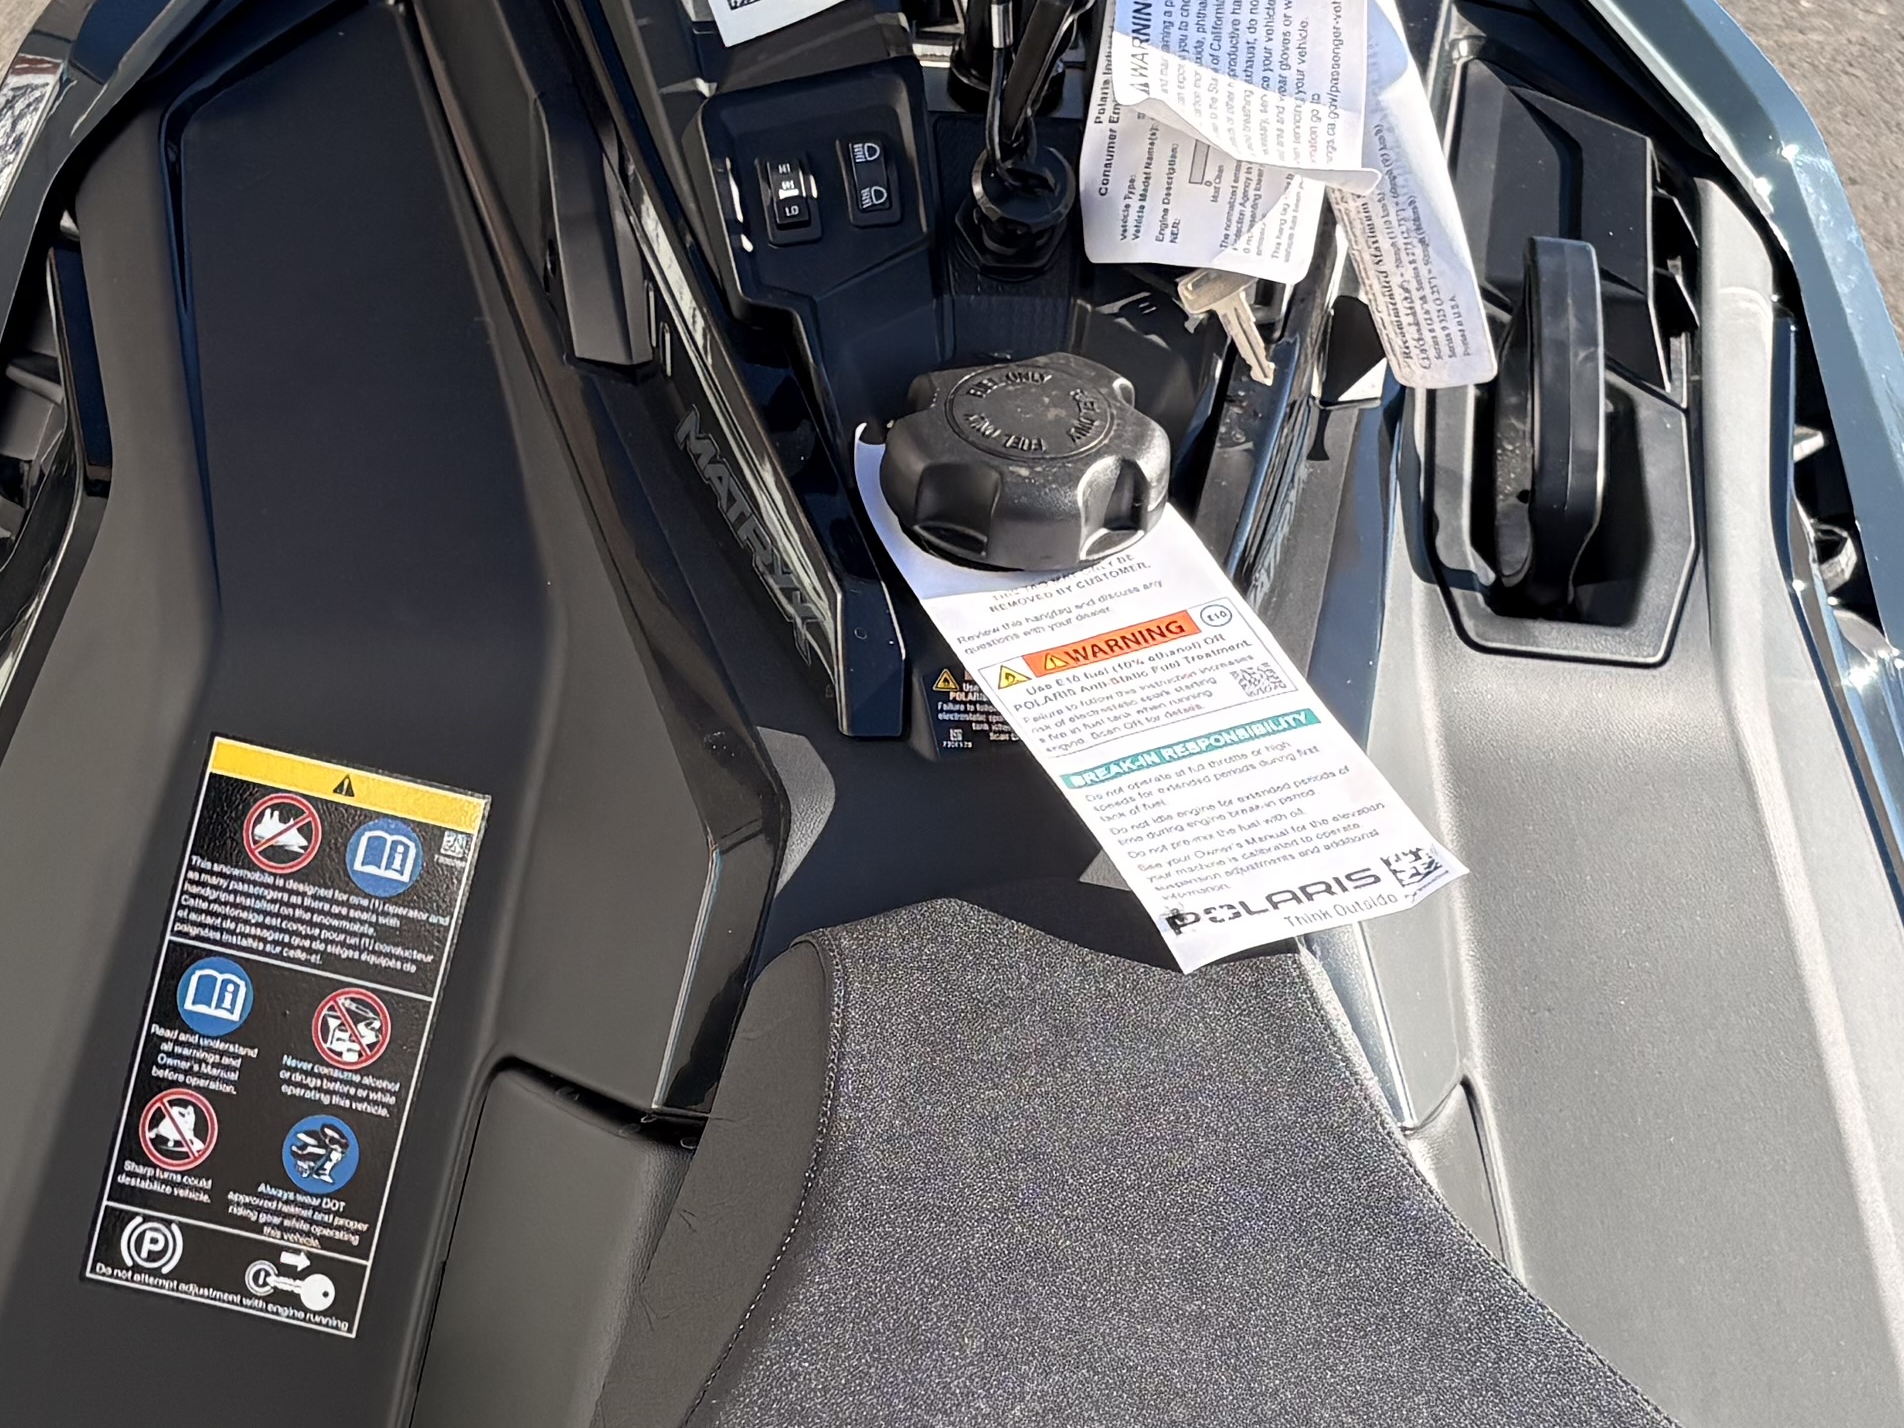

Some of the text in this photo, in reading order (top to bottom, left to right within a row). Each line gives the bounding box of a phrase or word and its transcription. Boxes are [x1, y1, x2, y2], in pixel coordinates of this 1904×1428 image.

[1164, 9, 1172, 17] a
[1177, 20, 1188, 31] to
[1245, 17, 1257, 34] do
[1282, 13, 1292, 26] or
[1177, 33, 1191, 53] you
[1277, 29, 1293, 72] gloves
[1208, 53, 1220, 65] of
[1261, 46, 1274, 73] your
[1097, 126, 1118, 196] Consumer
[785, 206, 799, 216] LO
[1005, 371, 1053, 385] ONLY
[987, 560, 1153, 613] REMOVED BY CUSTOMER.
[1062, 619, 1188, 664] WARNING
[1067, 709, 1311, 788] BREAK-IN RESPONSIBILITY
[1164, 867, 1382, 935] POLARIS
[1283, 891, 1398, 928] Think Outside
[149, 1024, 258, 1058] Read and understand
[159, 1039, 241, 1067] all warnings and
[150, 1065, 238, 1095] before operation.
[156, 1052, 239, 1081] Owner's Manual
[281, 1054, 401, 1092] Never consume alcohol
[278, 1069, 397, 1105] or drugs before or while
[280, 1083, 391, 1118] operating this vehicle.
[116, 1172, 212, 1203] destabilize vehicle.
[122, 1160, 212, 1189] Sharp turns could
[257, 1182, 346, 1212] Always wear DOT
[227, 1204, 360, 1245] riding gear while operating
[95, 1262, 349, 1332] Do not attempt adjustment with engine running
